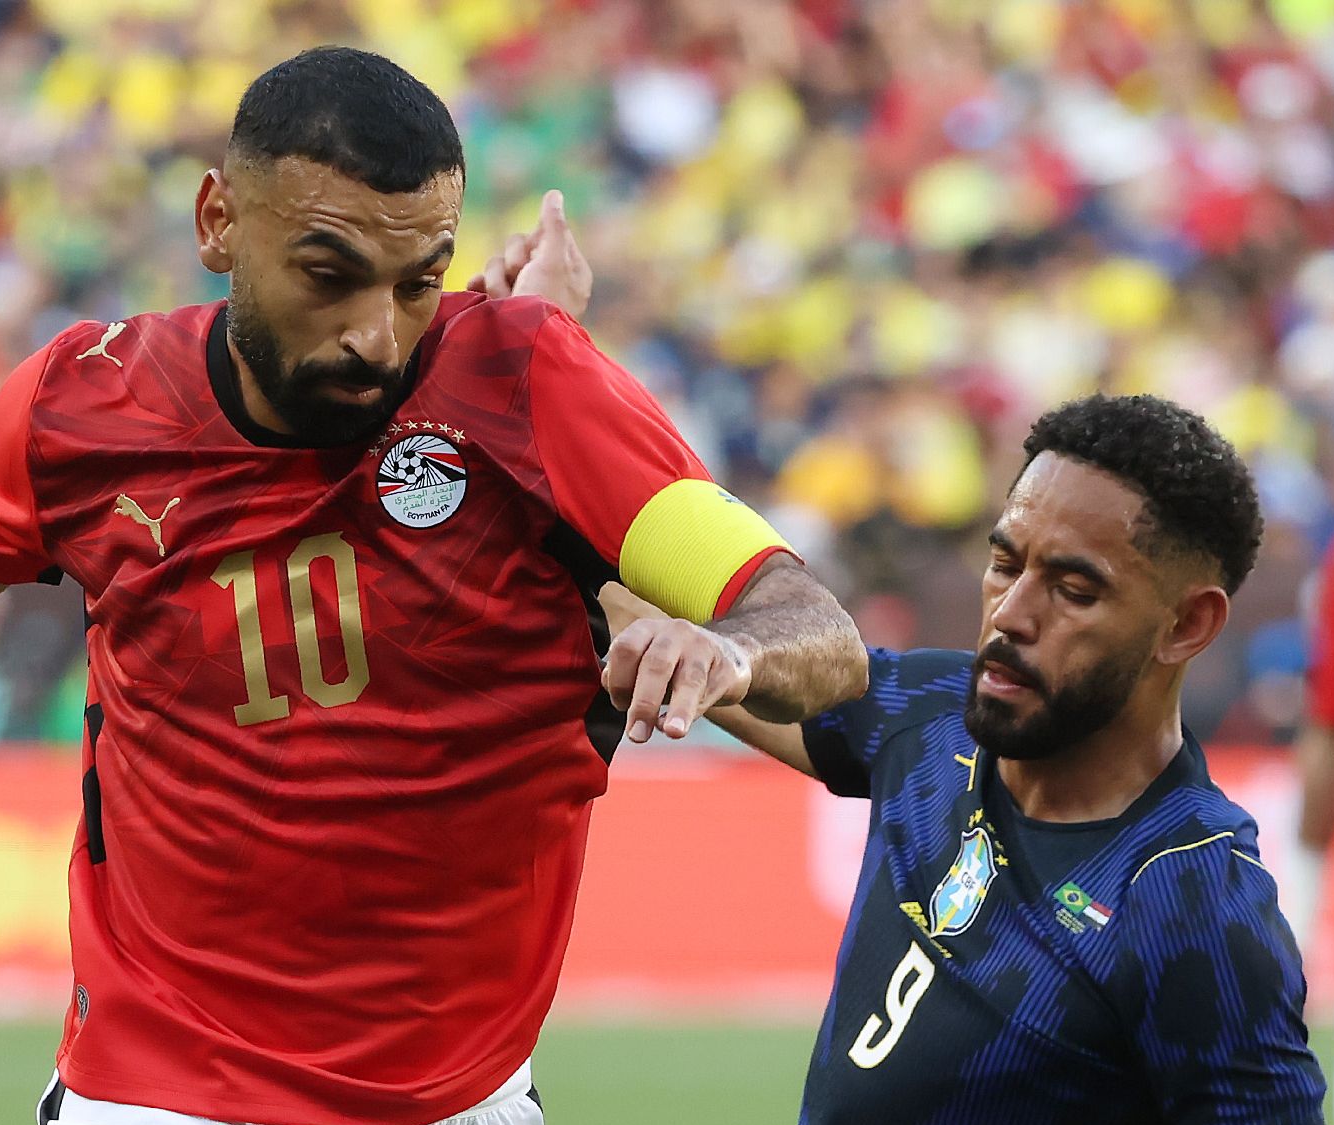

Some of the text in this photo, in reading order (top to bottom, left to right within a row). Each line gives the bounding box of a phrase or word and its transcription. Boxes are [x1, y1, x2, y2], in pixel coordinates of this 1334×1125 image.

[407, 503, 450, 520] EGYPTIAN FA
[210, 531, 370, 727] 10
[848, 940, 935, 1069] 9
